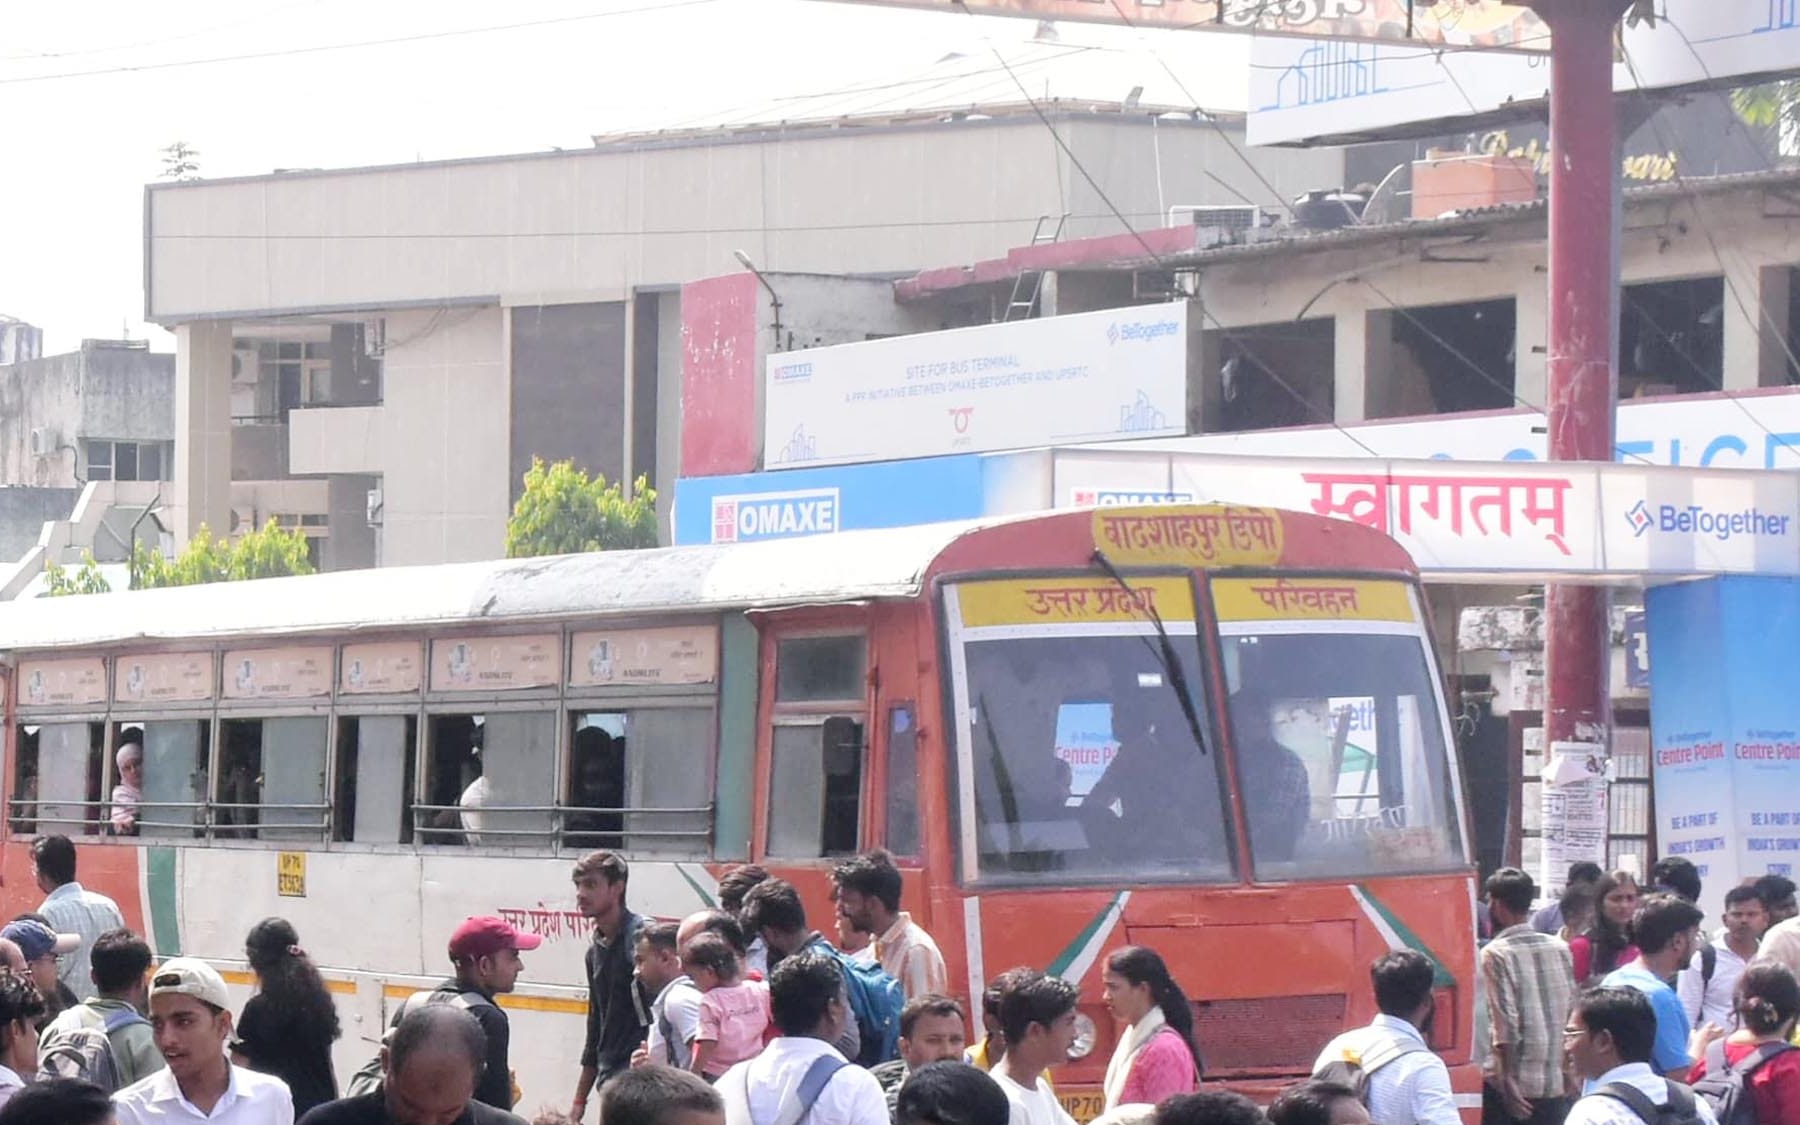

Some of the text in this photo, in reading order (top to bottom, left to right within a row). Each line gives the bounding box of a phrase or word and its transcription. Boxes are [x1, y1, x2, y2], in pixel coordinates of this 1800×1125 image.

[1120, 319, 1179, 344] BeTogether
[906, 353, 1020, 380] SITE FOR BUS TERMINAL
[739, 492, 834, 536] OMAXE
[1301, 473, 1571, 557] स्वागतम्
[1659, 503, 1791, 541] BeTogether
[1025, 580, 1157, 617] उत्तर प्रदेश
[1251, 578, 1358, 617] परिवहन
[1657, 741, 1724, 766] Centre Point
[1735, 743, 1774, 760] Centre
[1689, 813, 1707, 827] PART
[1771, 813, 1788, 825] PART
[1695, 836, 1725, 852] GROWTH
